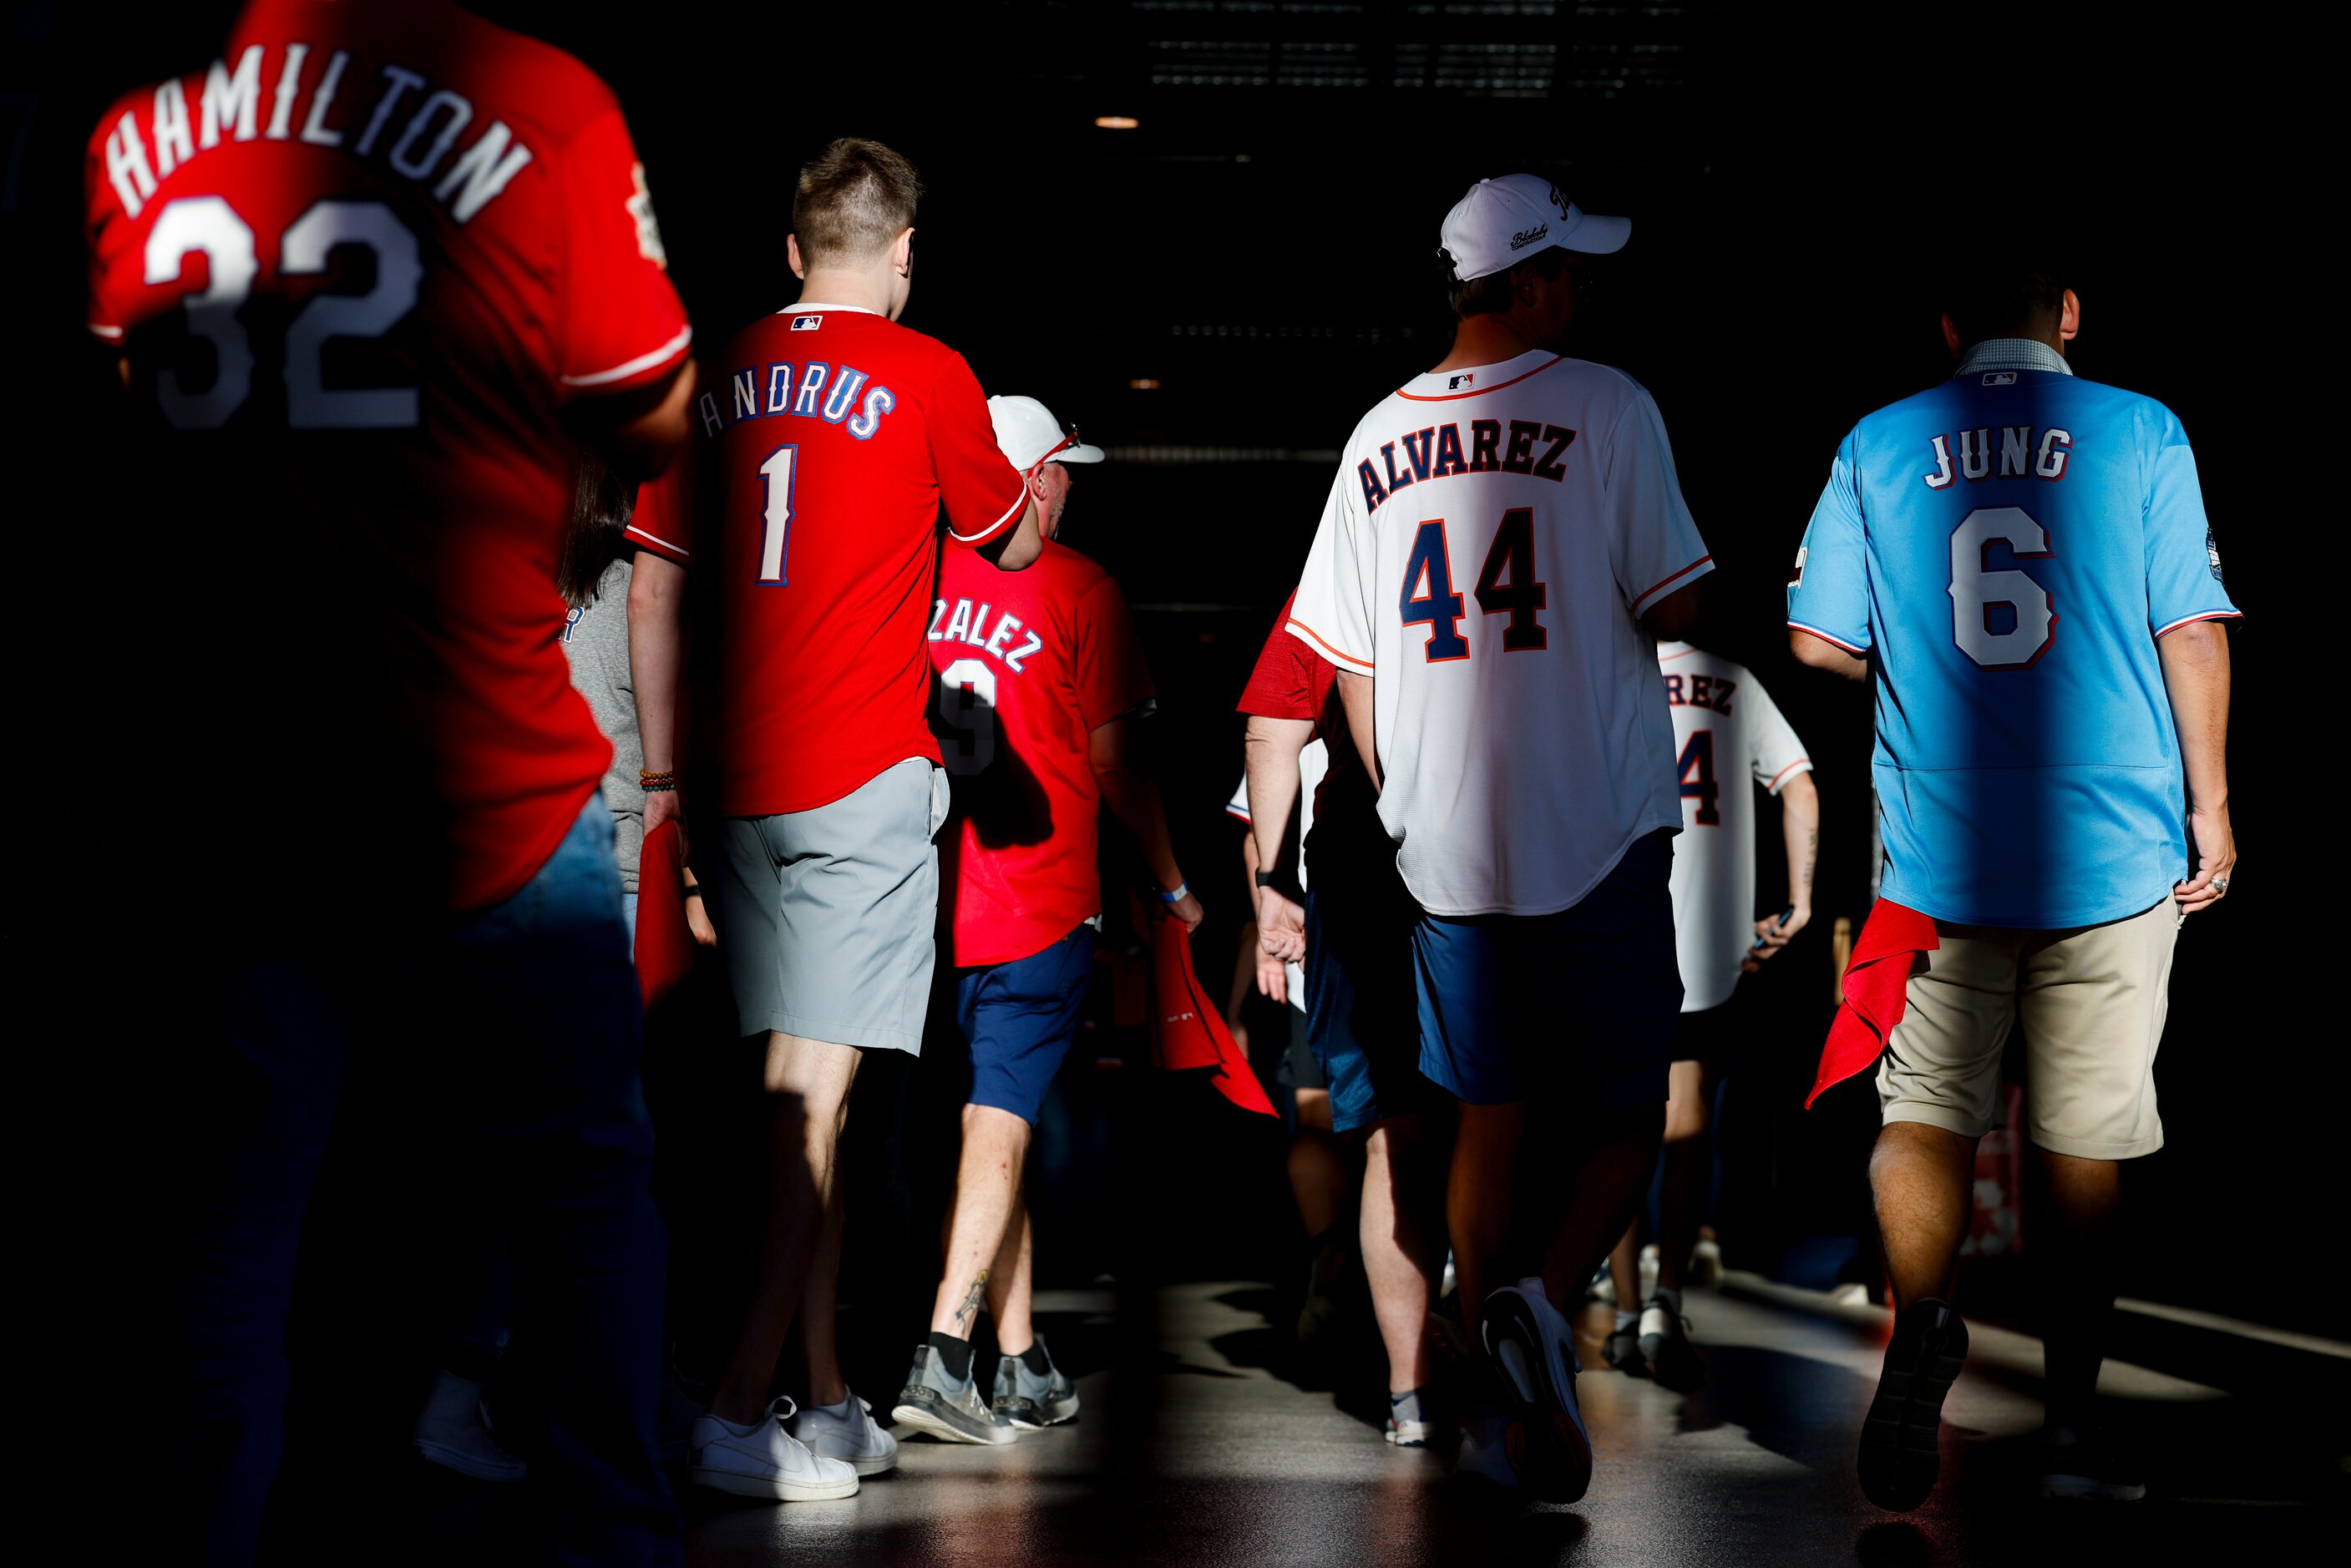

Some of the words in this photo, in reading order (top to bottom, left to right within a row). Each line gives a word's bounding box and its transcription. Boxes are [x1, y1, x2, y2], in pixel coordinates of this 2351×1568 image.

[105, 43, 534, 225] HAMILTON
[143, 194, 426, 431] 32
[700, 360, 897, 441] ANDRUS
[1923, 424, 2075, 491] JUNG
[756, 443, 798, 588] 1
[1358, 419, 1577, 515] ALVAREZ
[1399, 506, 1548, 664] 44
[1947, 504, 2059, 672] 6
[939, 657, 997, 777] 9
[1677, 728, 1720, 827] 4
